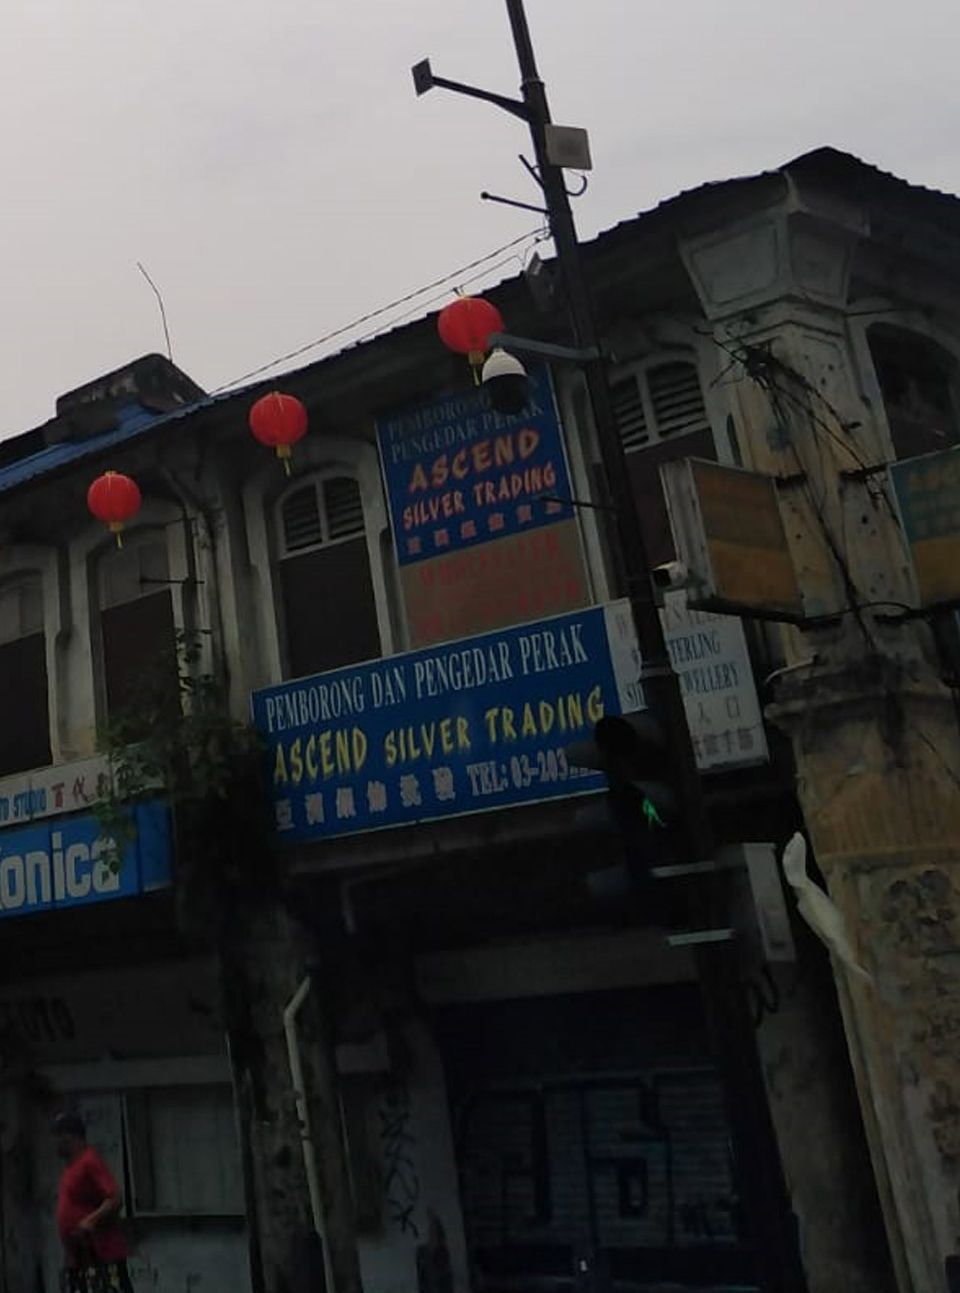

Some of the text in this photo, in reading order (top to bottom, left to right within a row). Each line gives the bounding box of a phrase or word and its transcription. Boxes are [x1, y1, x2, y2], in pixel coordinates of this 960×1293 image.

[391, 421, 480, 464] PENGEDAR
[409, 427, 540, 495] ASCEND
[403, 490, 465, 531] SILVER
[474, 460, 556, 507] TRADING
[265, 675, 365, 734] PEMBORONG
[370, 665, 407, 709] DAN
[413, 641, 514, 700] PENGEDAR
[518, 624, 589, 676] PERAK
[668, 632, 721, 664] TERLING
[273, 725, 368, 787] ASCEND
[384, 715, 471, 768] SILVER
[484, 684, 604, 744] TRADING
[510, 747, 588, 790] 03-203
